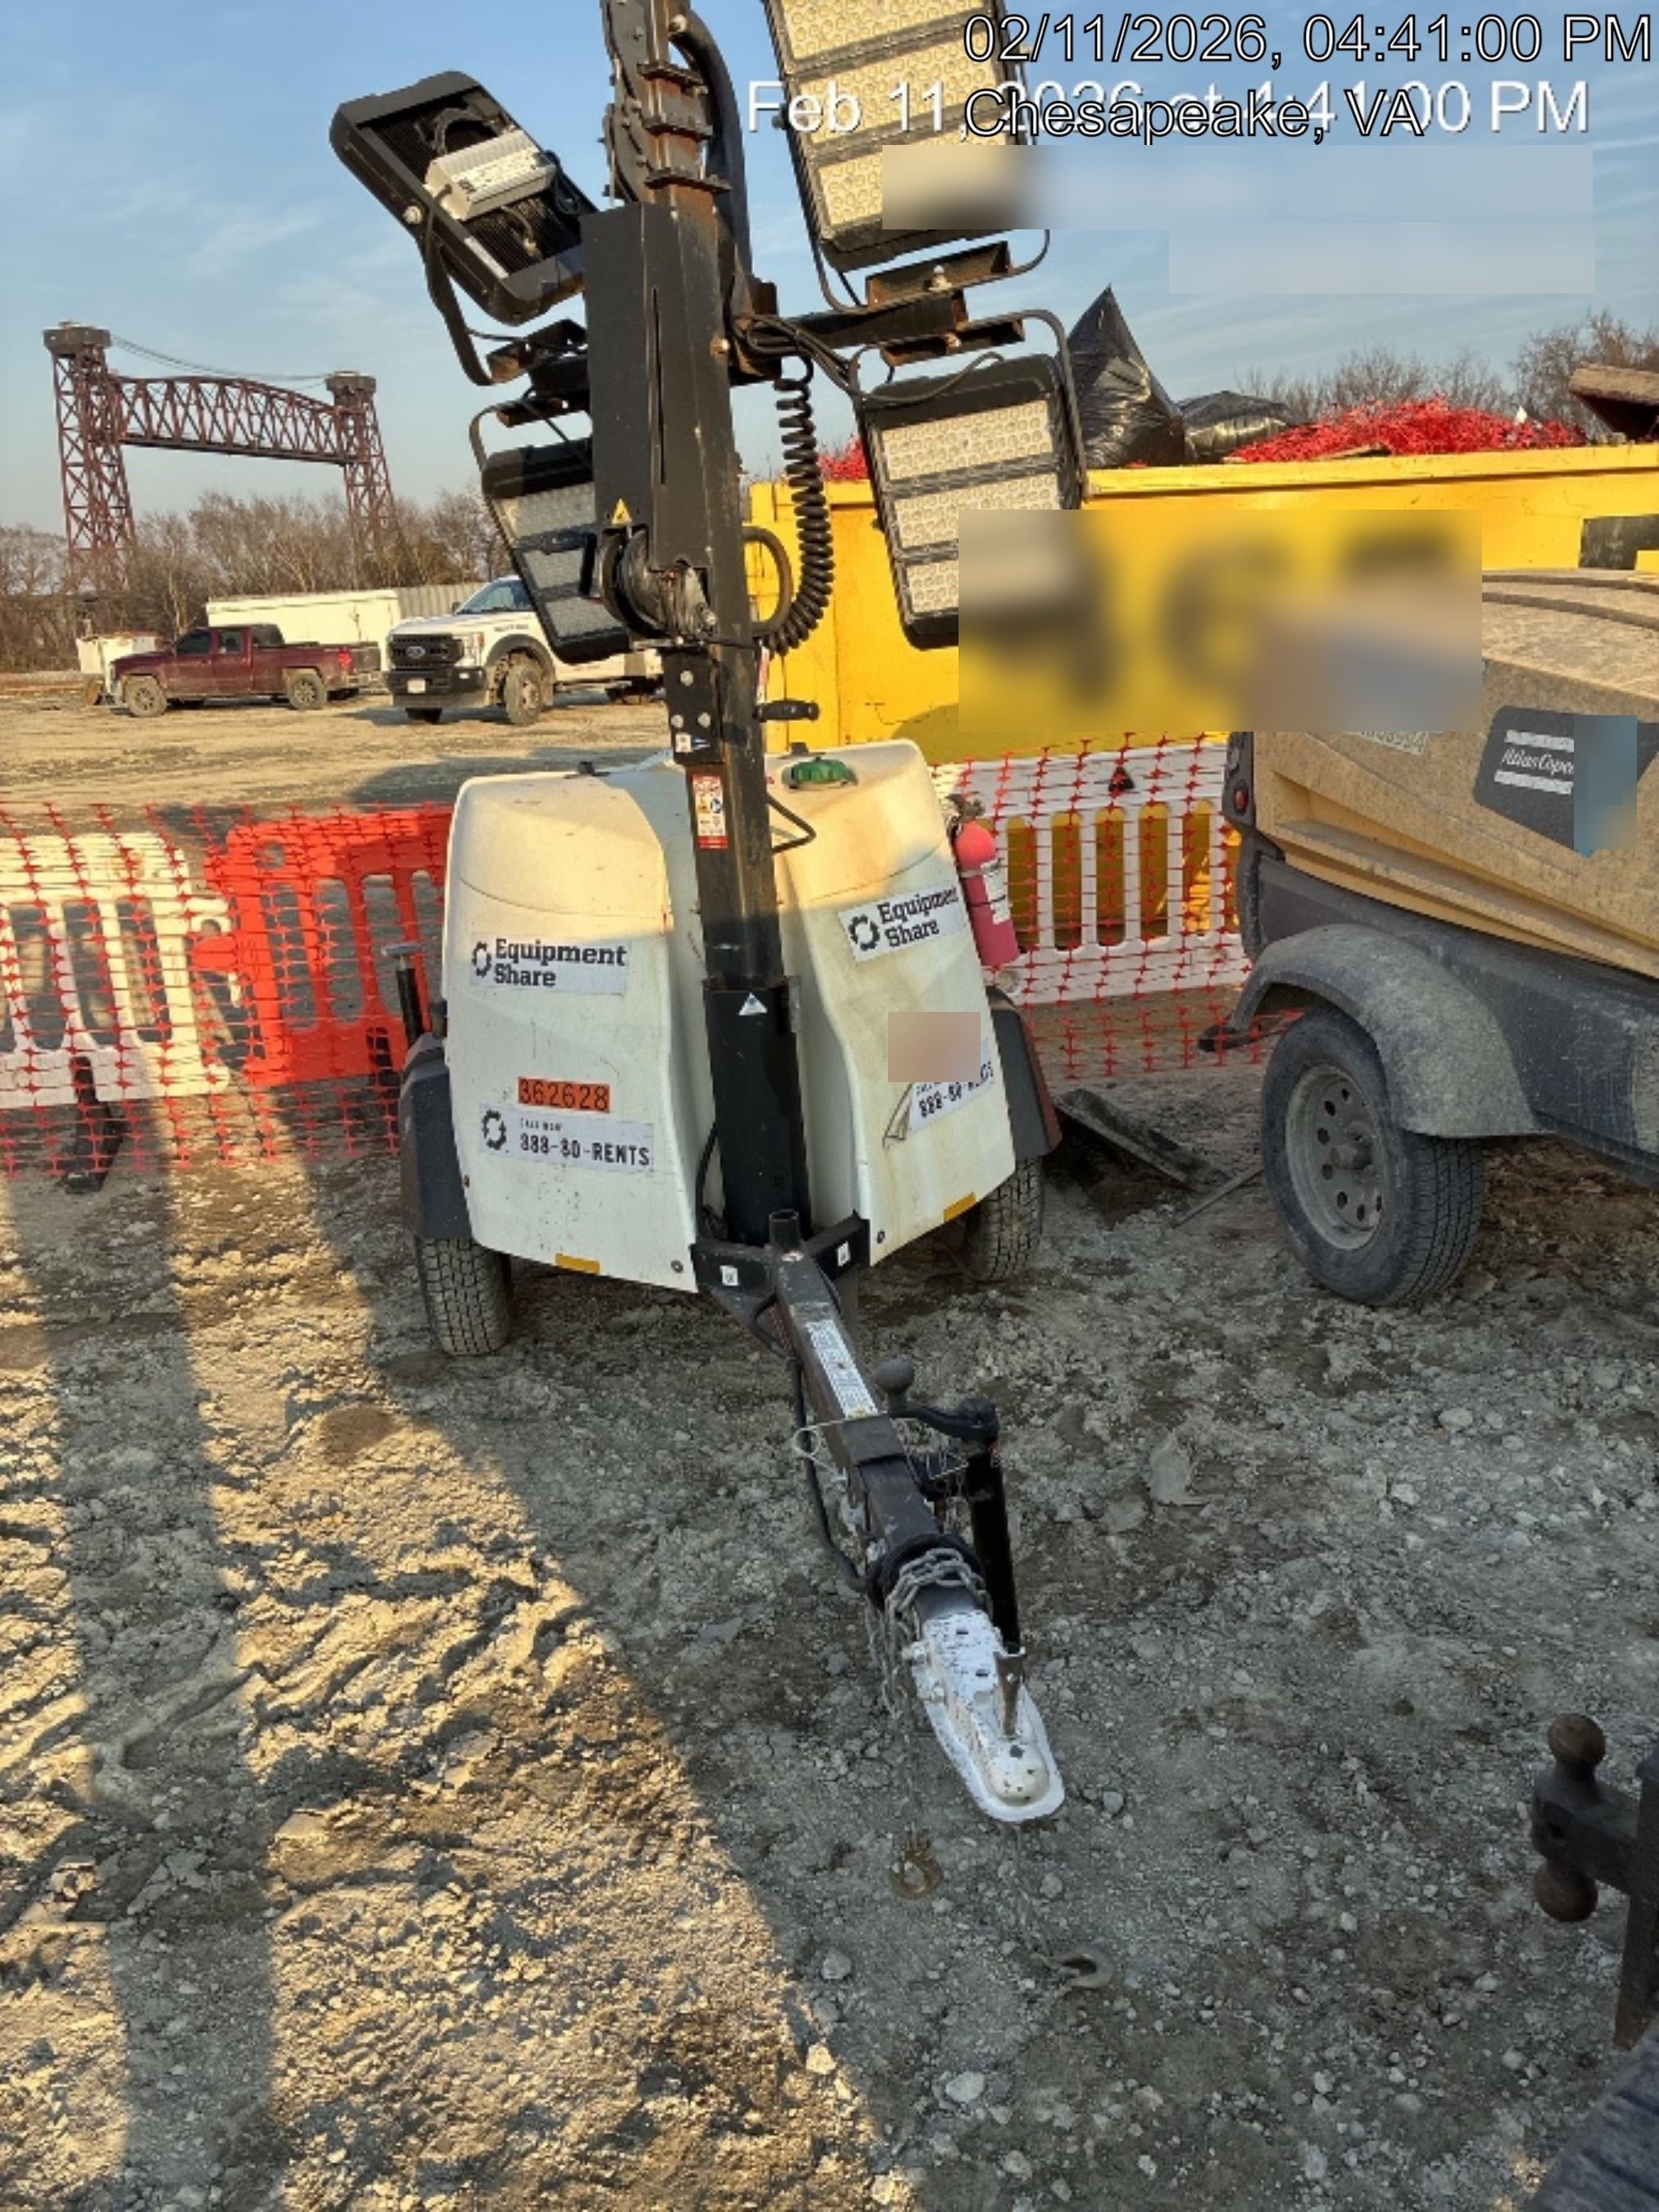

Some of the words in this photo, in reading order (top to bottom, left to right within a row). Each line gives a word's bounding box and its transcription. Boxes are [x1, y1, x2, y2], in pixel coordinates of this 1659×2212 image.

[885, 919, 940, 947] Share
[496, 938, 628, 966] Equipment
[494, 963, 556, 986] Share
[519, 1078, 610, 1111] 362628
